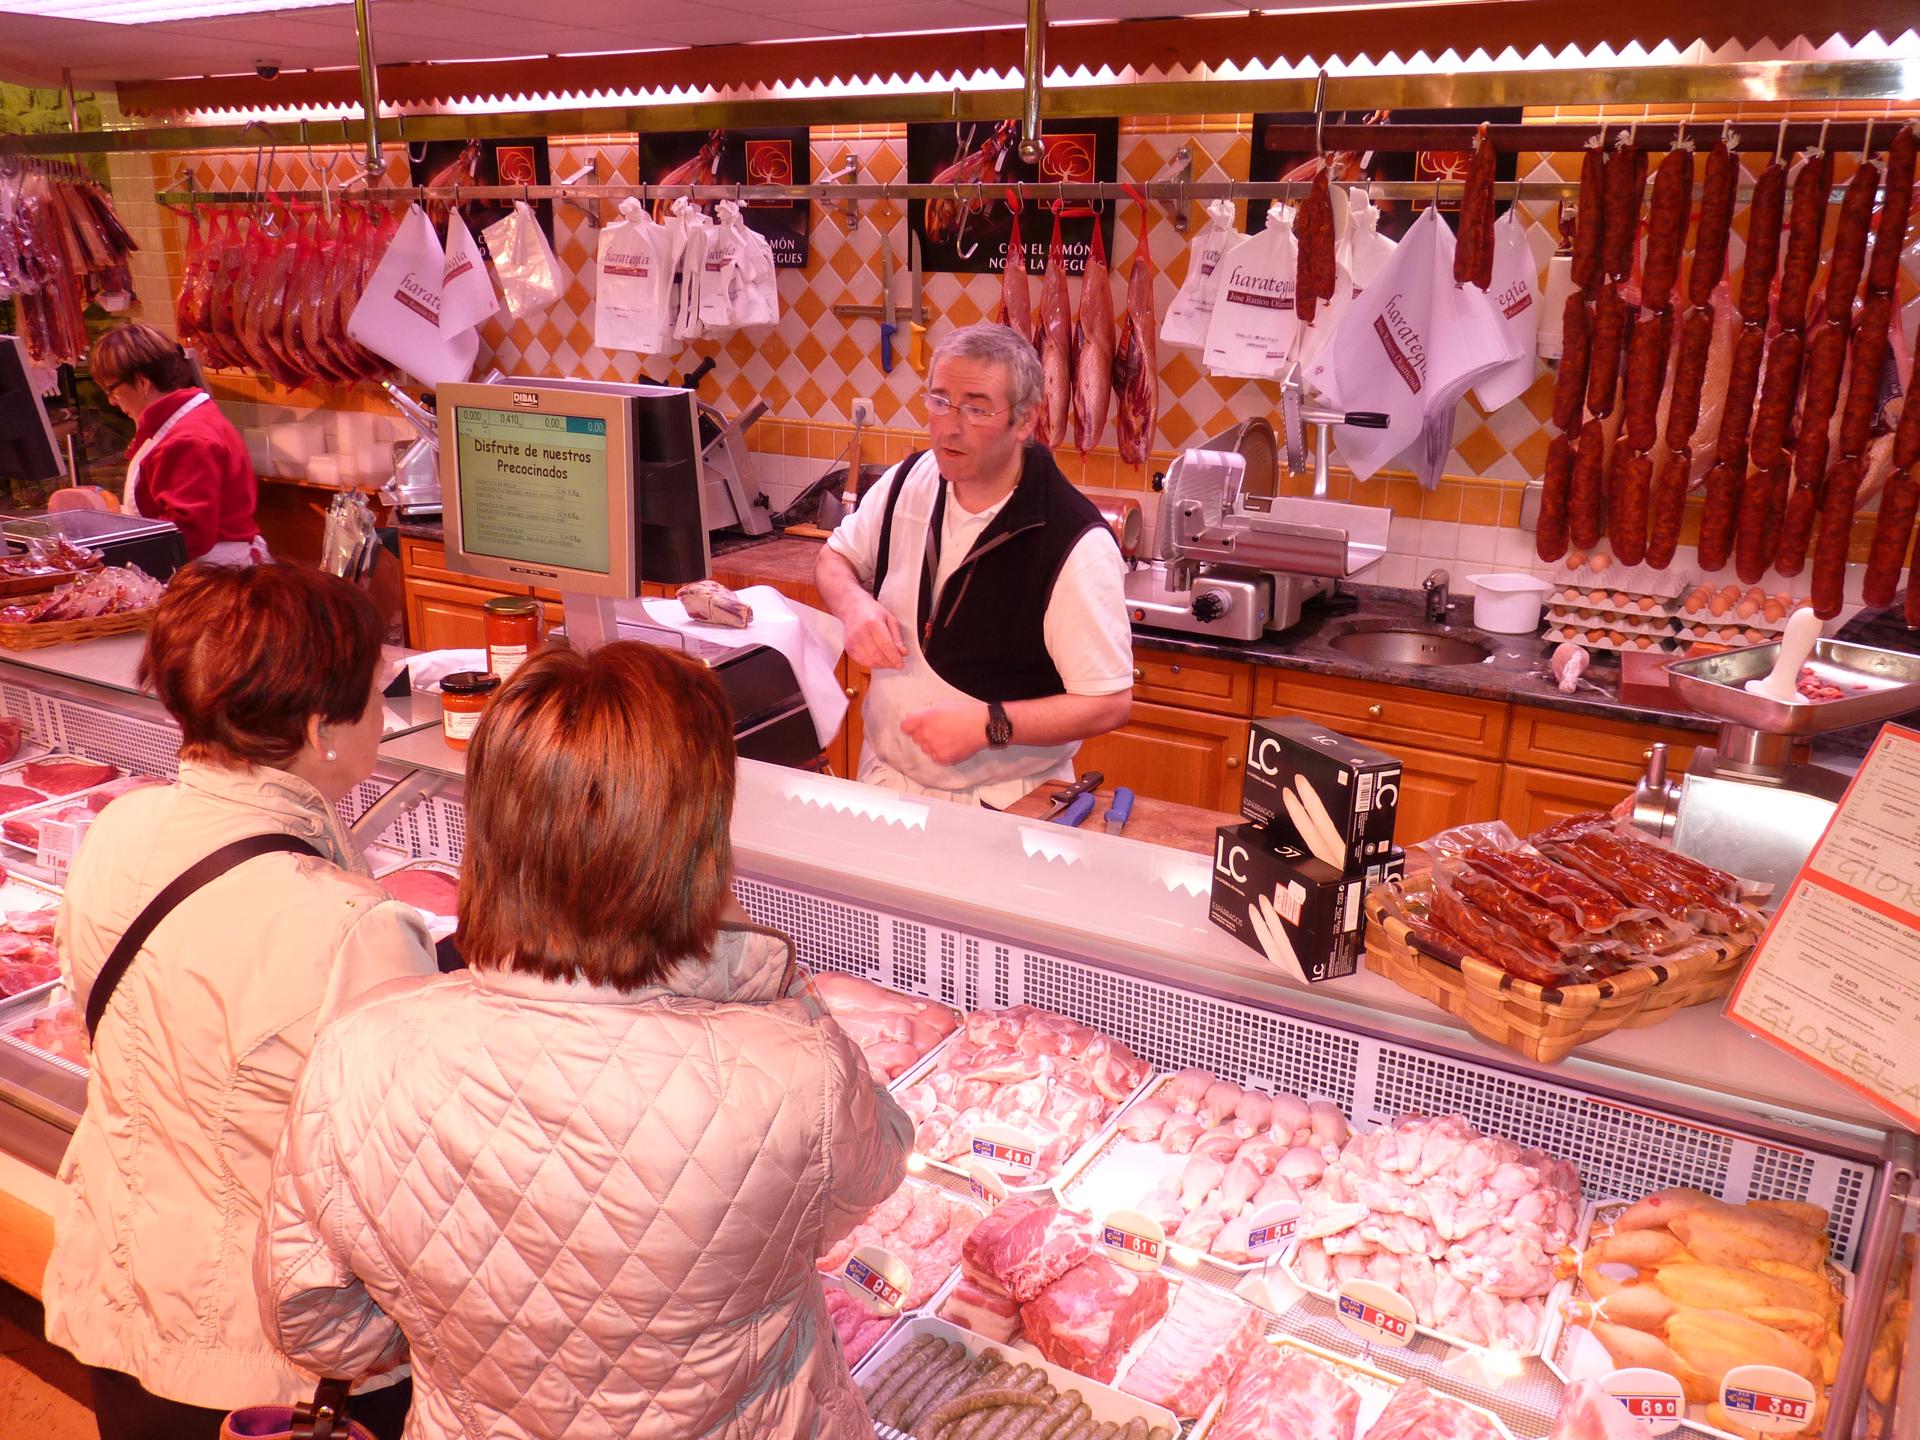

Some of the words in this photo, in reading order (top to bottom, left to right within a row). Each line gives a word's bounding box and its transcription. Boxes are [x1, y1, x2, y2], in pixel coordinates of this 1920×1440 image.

[766, 236, 795, 250] MÓN
[1031, 244, 1044, 255] EL
[1030, 259, 1045, 270] LA
[400, 272, 441, 311] harate
[1229, 292, 1245, 302] Jose
[513, 392, 538, 404] DIBAL
[474, 438, 520, 456] Disfrute
[524, 443, 538, 458] de
[543, 449, 592, 464] nuestros
[497, 459, 568, 480] Precocinados
[1311, 735, 1339, 746] LC
[1247, 729, 1281, 776] LC
[1375, 769, 1401, 810] LC
[1216, 835, 1250, 884] LC
[1311, 963, 1325, 981] LC
